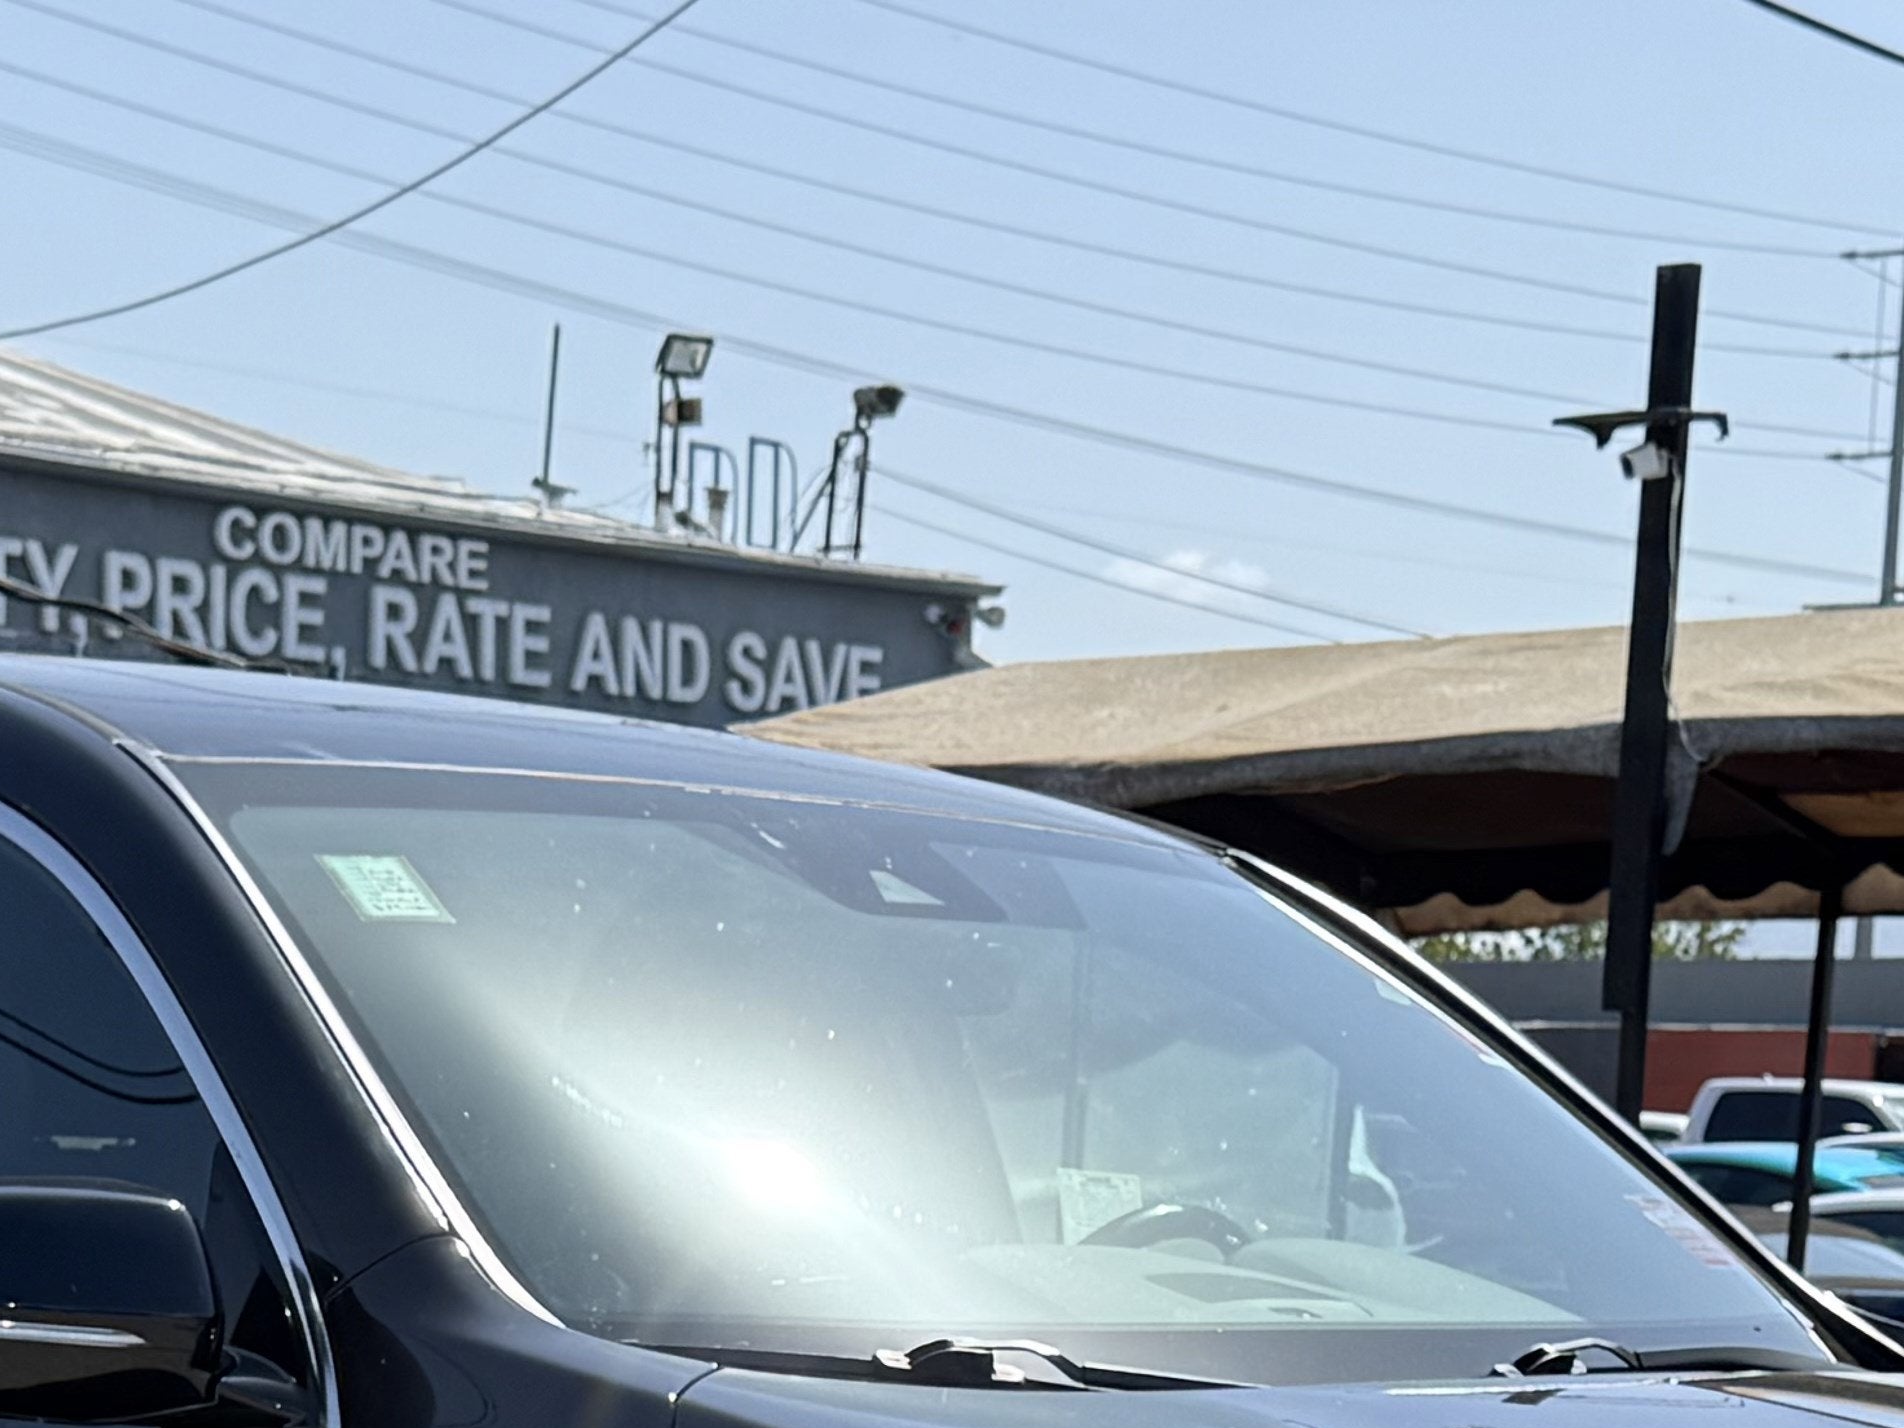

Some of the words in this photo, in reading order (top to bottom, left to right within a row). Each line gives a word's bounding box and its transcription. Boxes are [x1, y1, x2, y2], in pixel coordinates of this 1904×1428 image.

[212, 505, 490, 591] COMPARE
[103, 550, 348, 680] PRICE,
[367, 584, 553, 689] RATE
[570, 611, 711, 703] AND
[724, 630, 885, 713] SAVE
